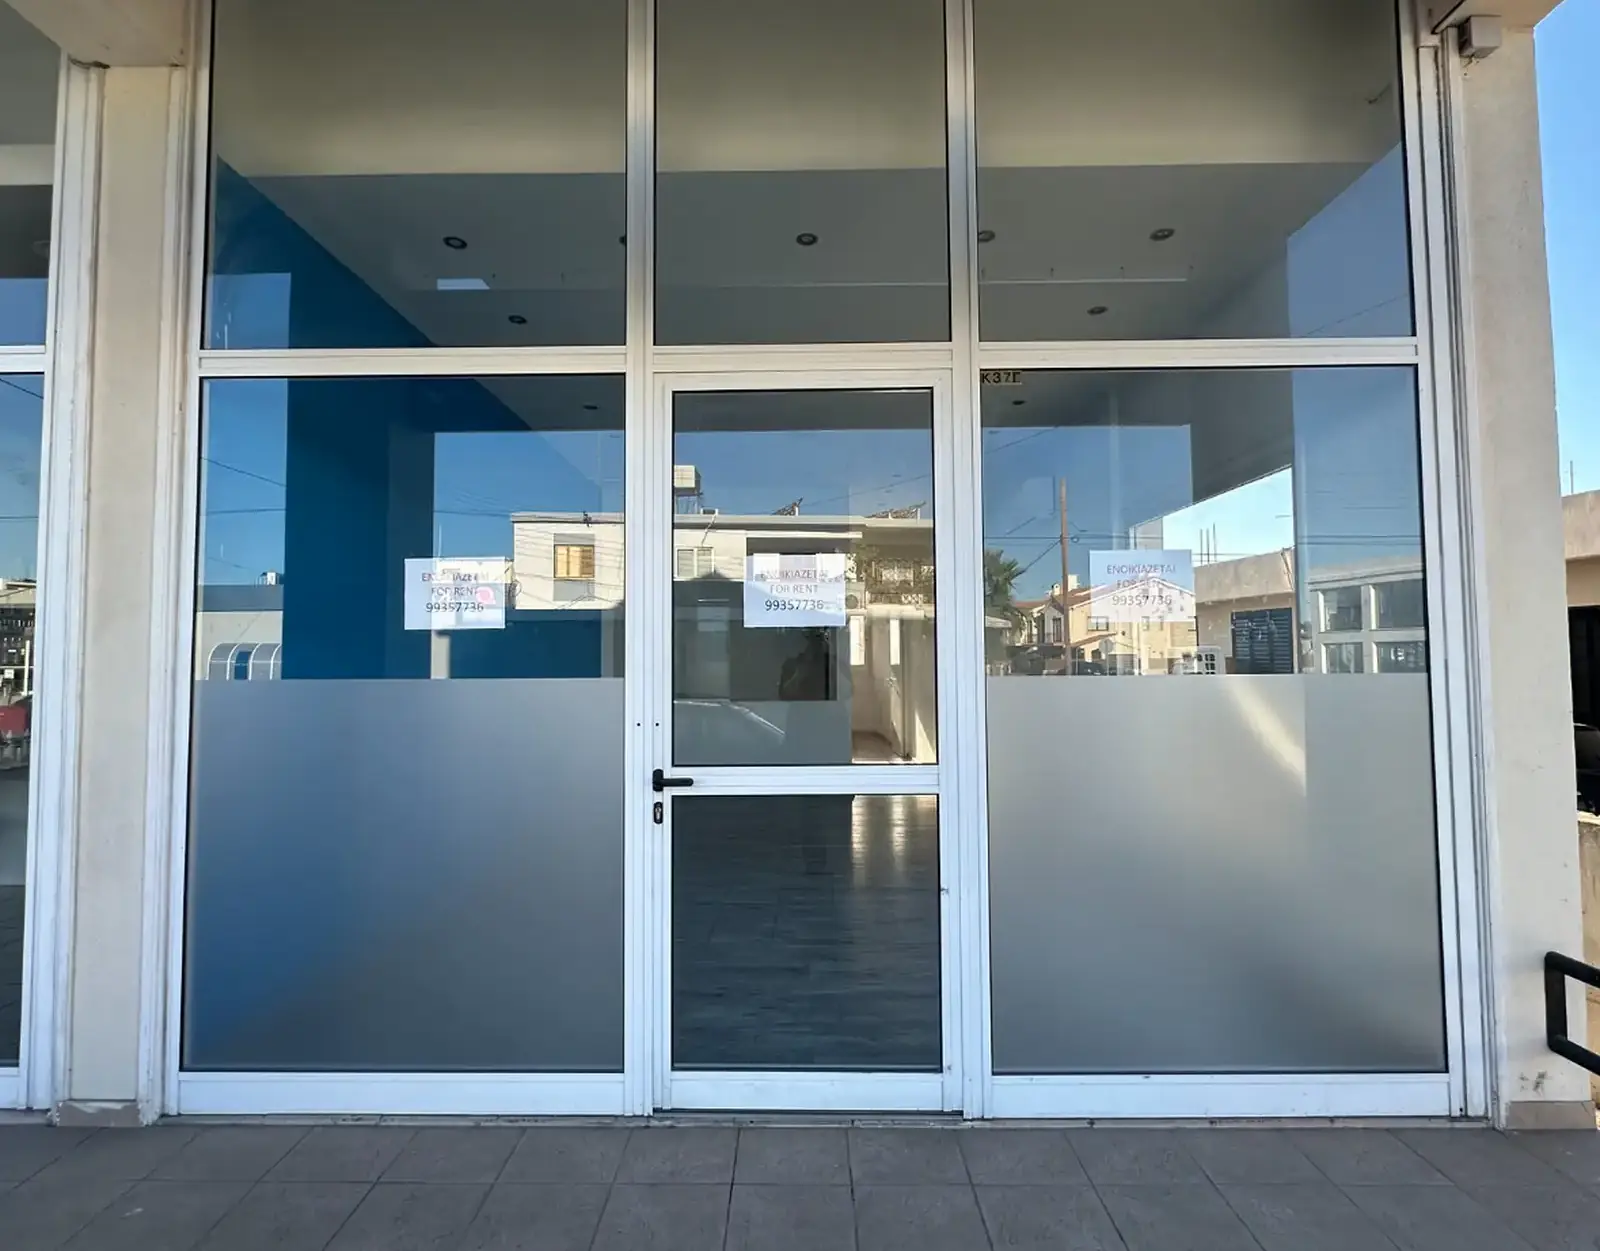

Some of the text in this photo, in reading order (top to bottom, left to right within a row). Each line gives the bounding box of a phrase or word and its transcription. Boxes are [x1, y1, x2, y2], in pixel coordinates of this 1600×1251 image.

[770, 584, 818, 593] FOR RENT
[765, 599, 824, 611] 99357736
[1112, 595, 1172, 606] 99357736
[426, 602, 484, 612] 99357736
